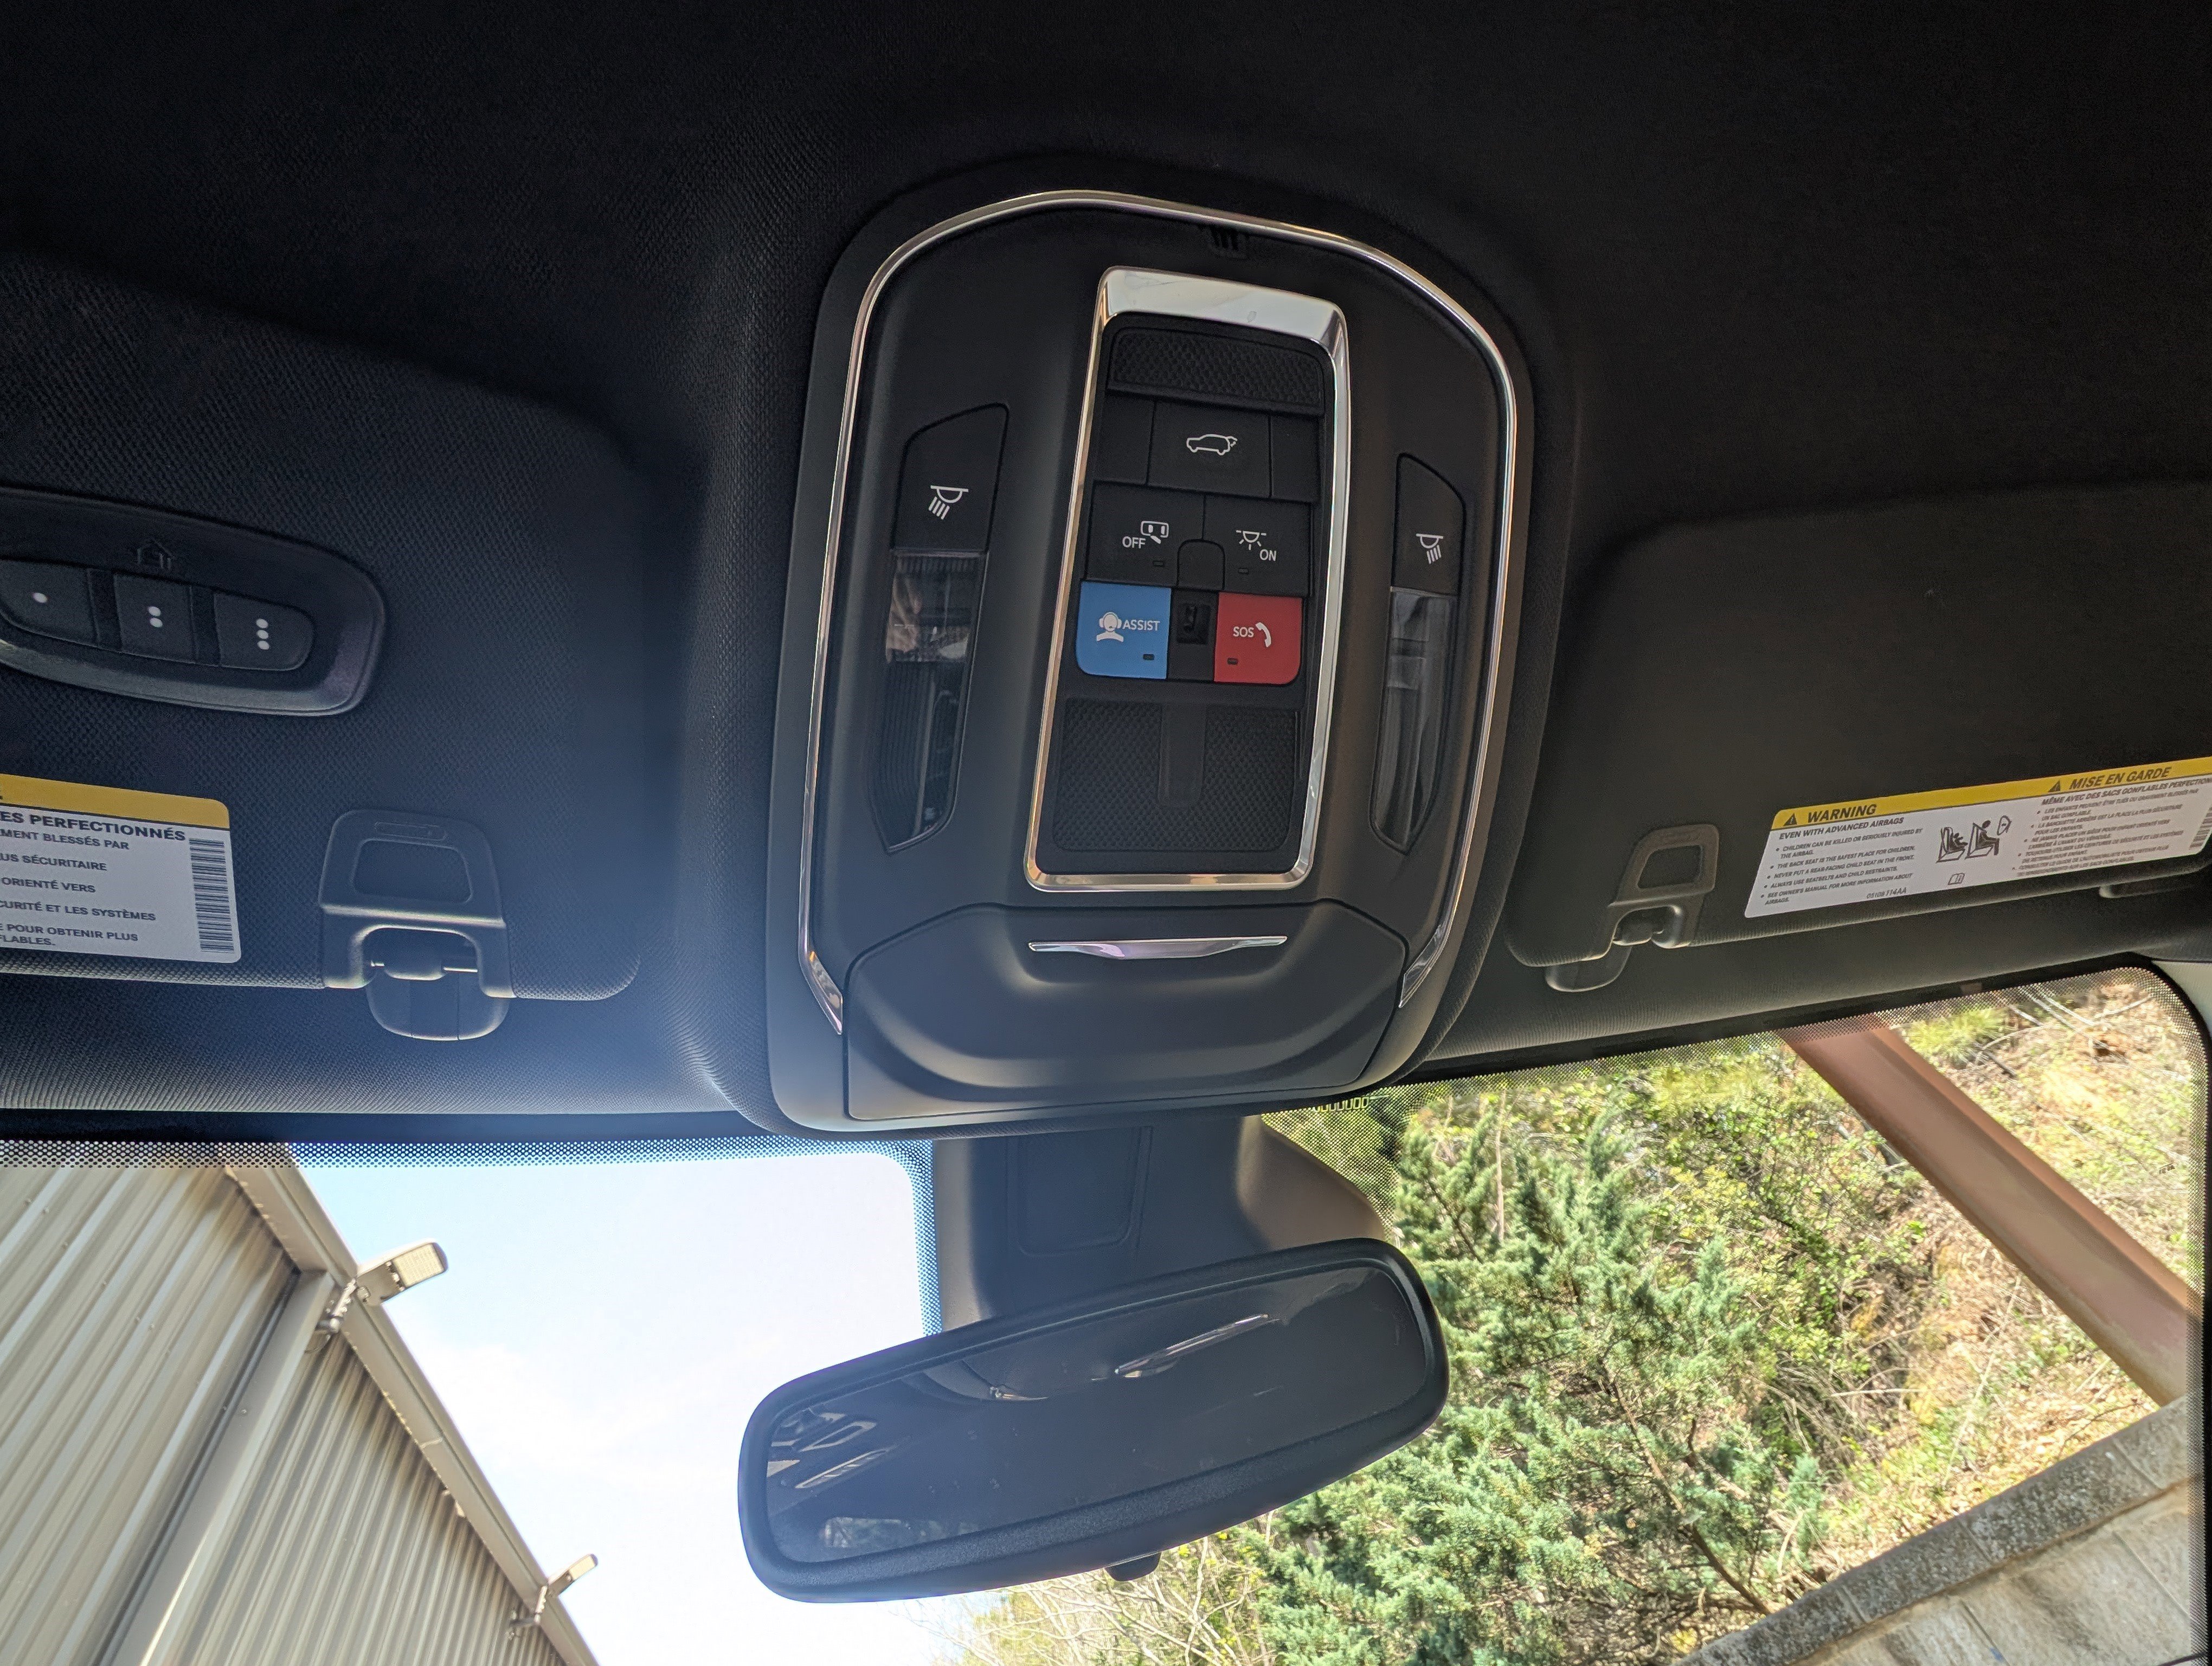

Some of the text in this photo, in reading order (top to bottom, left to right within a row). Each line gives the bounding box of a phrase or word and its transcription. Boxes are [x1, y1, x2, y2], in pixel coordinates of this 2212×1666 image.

[1122, 536, 1146, 549] OFF
[1259, 549, 1276, 561] ON
[1122, 619, 1160, 631] ASSIST
[1233, 626, 1254, 637] SOS
[2069, 767, 2172, 790] MISE EN GARDE
[2065, 793, 2086, 803] AVEC
[2100, 788, 2122, 797] SACS
[2122, 783, 2169, 794] GONFLABLES
[1808, 804, 1877, 823] WARNING
[30, 814, 185, 841] PERFECTIONNÉS
[1779, 817, 1904, 840] EVEN WITH ADVANCED AIRBAGS
[43, 833, 100, 847] BLESSÉS
[104, 840, 130, 850] PAR
[1783, 842, 1811, 851] CHILDREN
[1862, 832, 1891, 841] SERIOUSLY
[1887, 845, 1915, 854] CHILDREN.
[1792, 849, 1814, 858] AIRBAG.
[22, 855, 107, 872] SÉCURITAIRE
[2, 877, 96, 893] ORIENTÉ VERS
[1779, 888, 1803, 896] OWNER'S
[46, 904, 60, 913] ET
[65, 906, 88, 915] LES
[92, 908, 156, 921] SYSTÈMES
[7, 924, 44, 934] POUR
[47, 927, 103, 939] OBTENIR
[107, 932, 138, 941] PLUS
